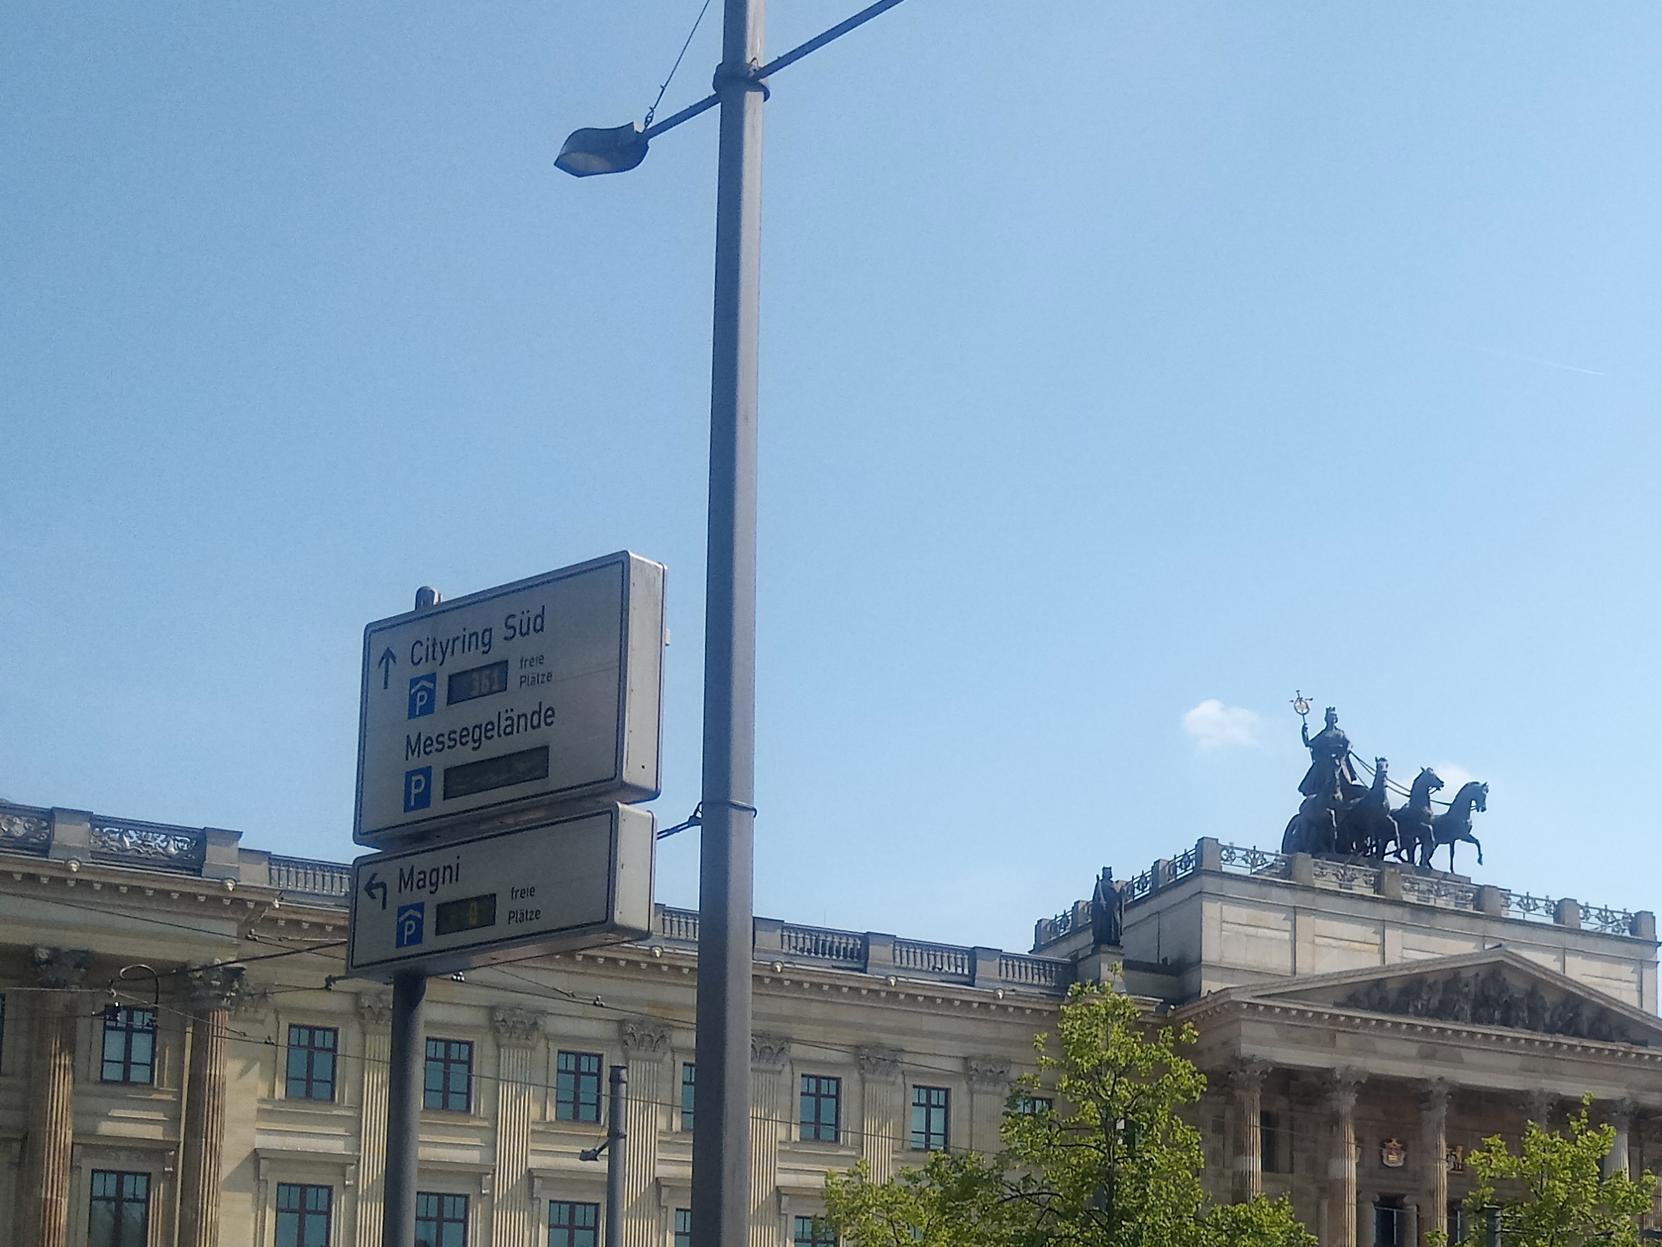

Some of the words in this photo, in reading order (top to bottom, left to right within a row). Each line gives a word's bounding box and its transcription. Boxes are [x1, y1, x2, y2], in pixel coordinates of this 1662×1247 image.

[411, 627, 493, 667] Cityring
[503, 605, 545, 641] Süd
[520, 653, 545, 669] freie
[520, 671, 553, 688] Plätze
[405, 701, 556, 761] Messegelände
[410, 775, 426, 807] P
[398, 855, 461, 895] Magni
[511, 886, 536, 900] freie
[508, 907, 542, 925] Plätze
